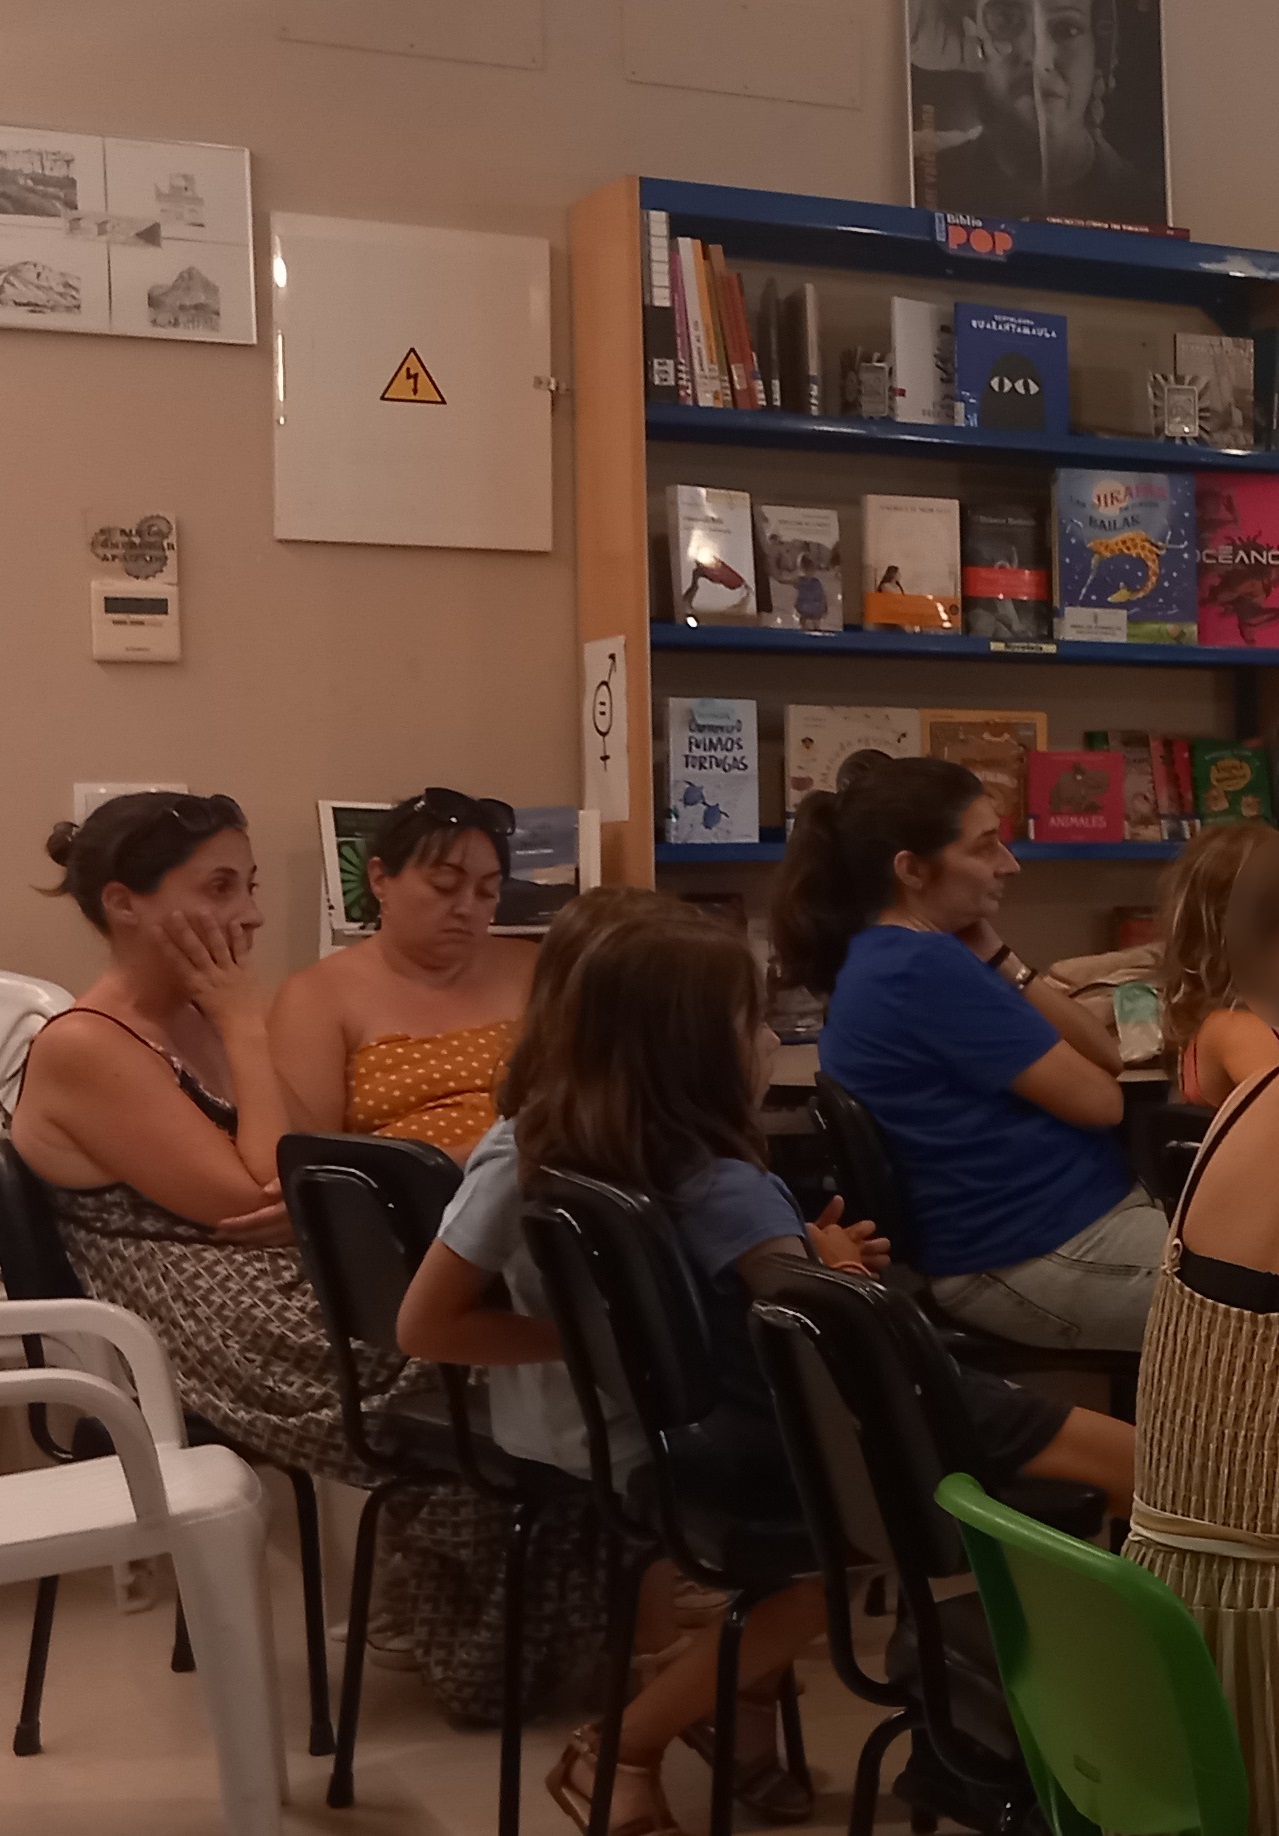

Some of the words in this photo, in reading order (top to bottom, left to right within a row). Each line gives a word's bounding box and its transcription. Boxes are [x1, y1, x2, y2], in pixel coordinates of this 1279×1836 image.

[948, 225, 1013, 256] POP
[688, 736, 744, 753] FUIMOS
[683, 754, 749, 773] TORTUGAS
